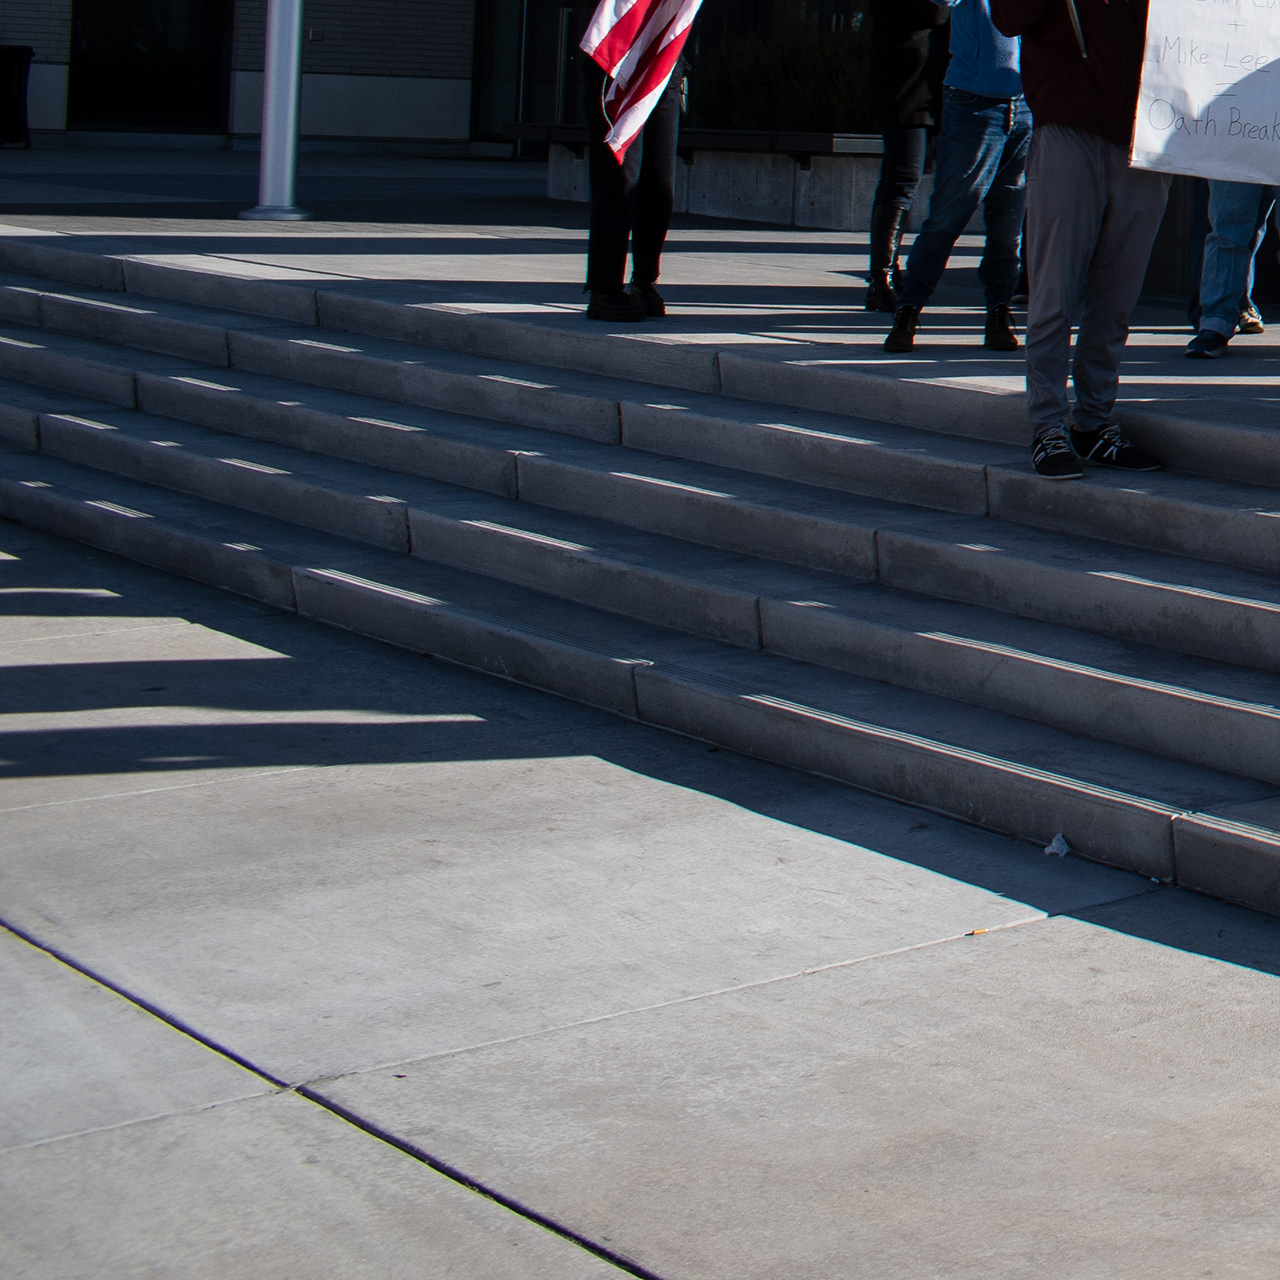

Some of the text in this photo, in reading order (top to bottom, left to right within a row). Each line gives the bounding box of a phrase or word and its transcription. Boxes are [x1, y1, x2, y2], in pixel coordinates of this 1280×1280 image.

[1162, 36, 1271, 73] Mike Lee
[1148, 98, 1217, 137] Oath
